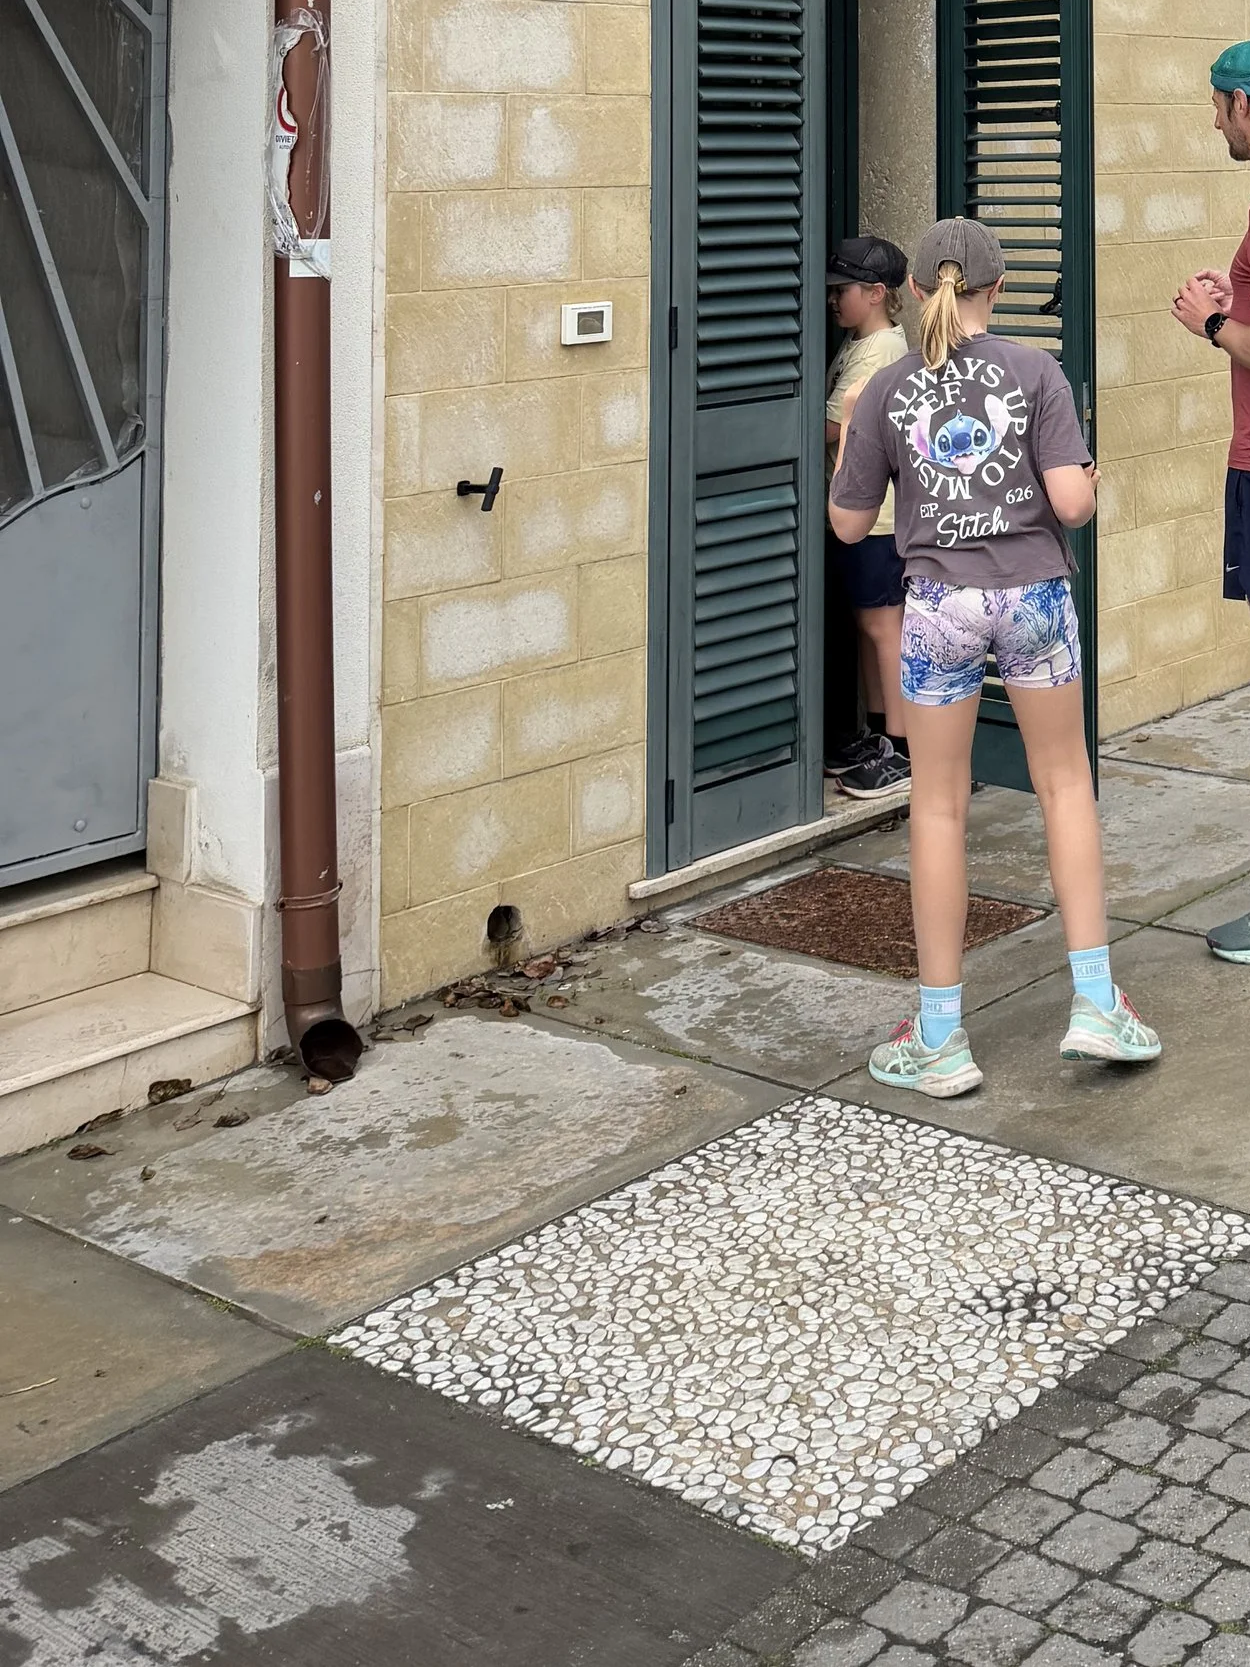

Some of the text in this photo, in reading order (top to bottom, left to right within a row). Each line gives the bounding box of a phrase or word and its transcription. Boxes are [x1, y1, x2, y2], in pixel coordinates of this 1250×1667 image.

[276, 135, 296, 143] DIVIET
[888, 357, 1005, 431] ALWAYS
[1003, 386, 1028, 435] UP
[982, 445, 1022, 486] TO
[1005, 485, 1034, 504] 626
[937, 506, 1010, 548] Stitch
